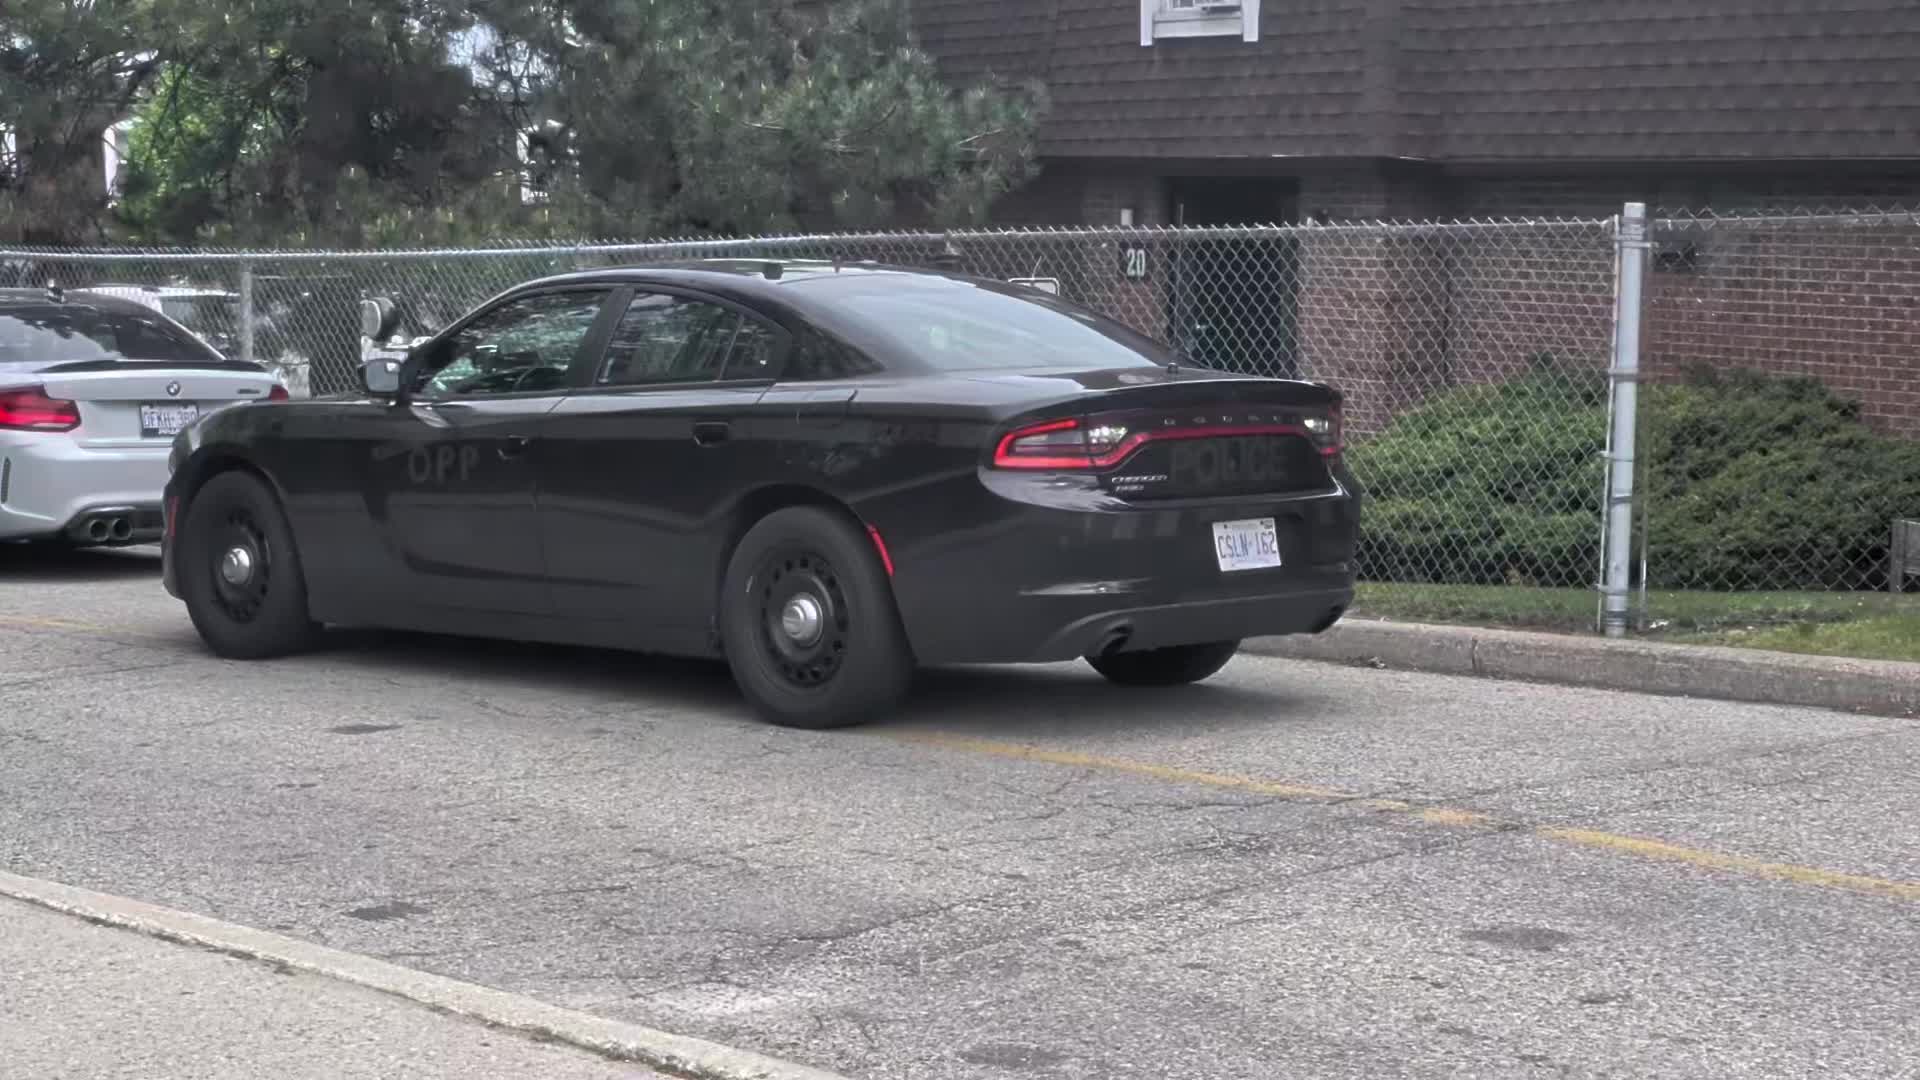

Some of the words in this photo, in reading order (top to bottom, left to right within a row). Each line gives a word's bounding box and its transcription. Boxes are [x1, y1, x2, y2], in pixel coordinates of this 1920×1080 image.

[1126, 249, 1146, 277] 20
[407, 445, 480, 485] OPP
[1170, 437, 1287, 484] POLICE
